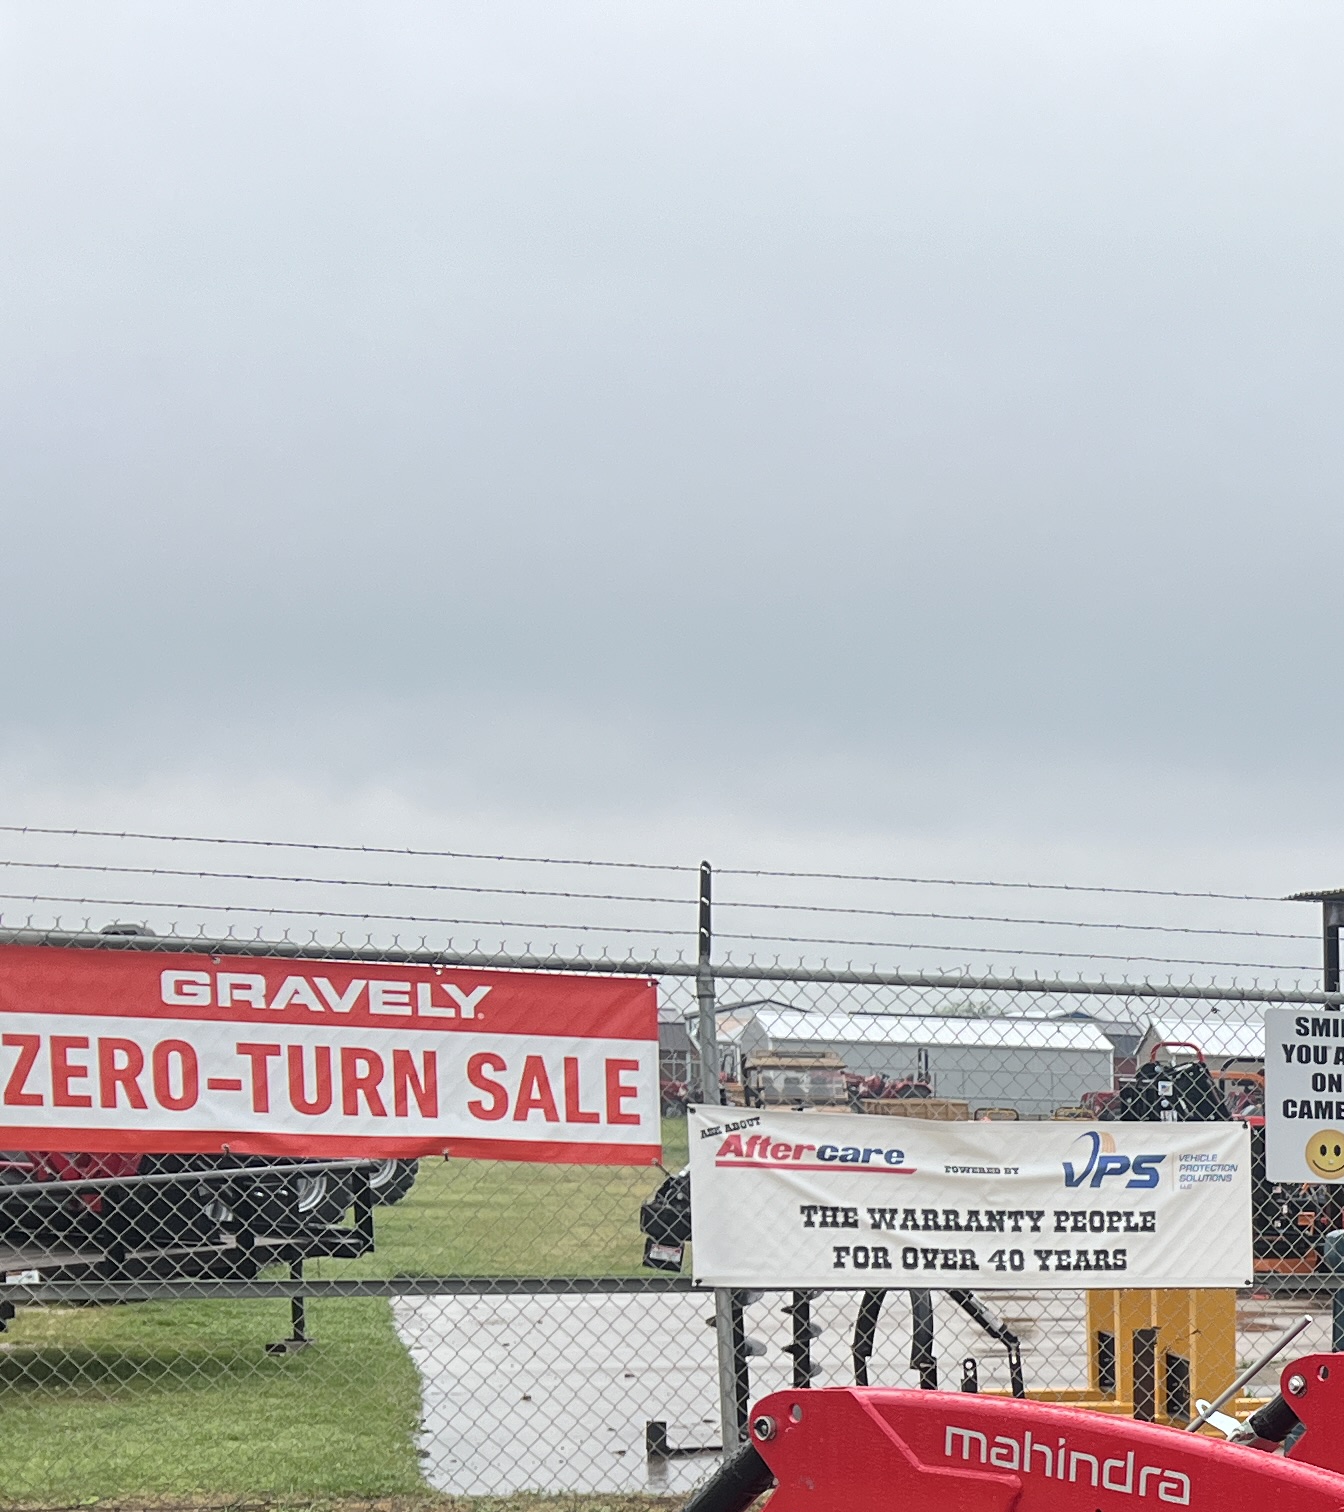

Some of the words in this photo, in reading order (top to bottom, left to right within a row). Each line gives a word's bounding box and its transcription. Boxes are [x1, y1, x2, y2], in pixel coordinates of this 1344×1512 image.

[160, 968, 492, 1020] GRAVELY
[1282, 1044, 1328, 1065] YOU
[1, 1032, 438, 1119] ZERO-TURN
[466, 1051, 641, 1125] SALE
[1311, 1072, 1342, 1093] ON
[700, 1125, 722, 1139] ASK
[725, 1116, 761, 1133] ABOUT
[715, 1133, 905, 1165] Aftercare
[1062, 1131, 1167, 1189] VPS
[1179, 1153, 1217, 1162] VEHICLE
[944, 1165, 1000, 1175] POWERED
[1004, 1166, 1019, 1175] BY
[1179, 1163, 1238, 1172] PROTECTION
[1179, 1173, 1232, 1182] SOLUTIONS
[799, 1204, 859, 1229] THE
[869, 1206, 1047, 1234] WARRANTY
[1053, 1210, 1157, 1233] PEOPLE
[832, 1245, 892, 1270] FOR
[901, 1246, 980, 1271] OVER
[987, 1248, 1025, 1271] 40
[1033, 1248, 1128, 1271] YEARS
[944, 1424, 1192, 1506] mahindra
